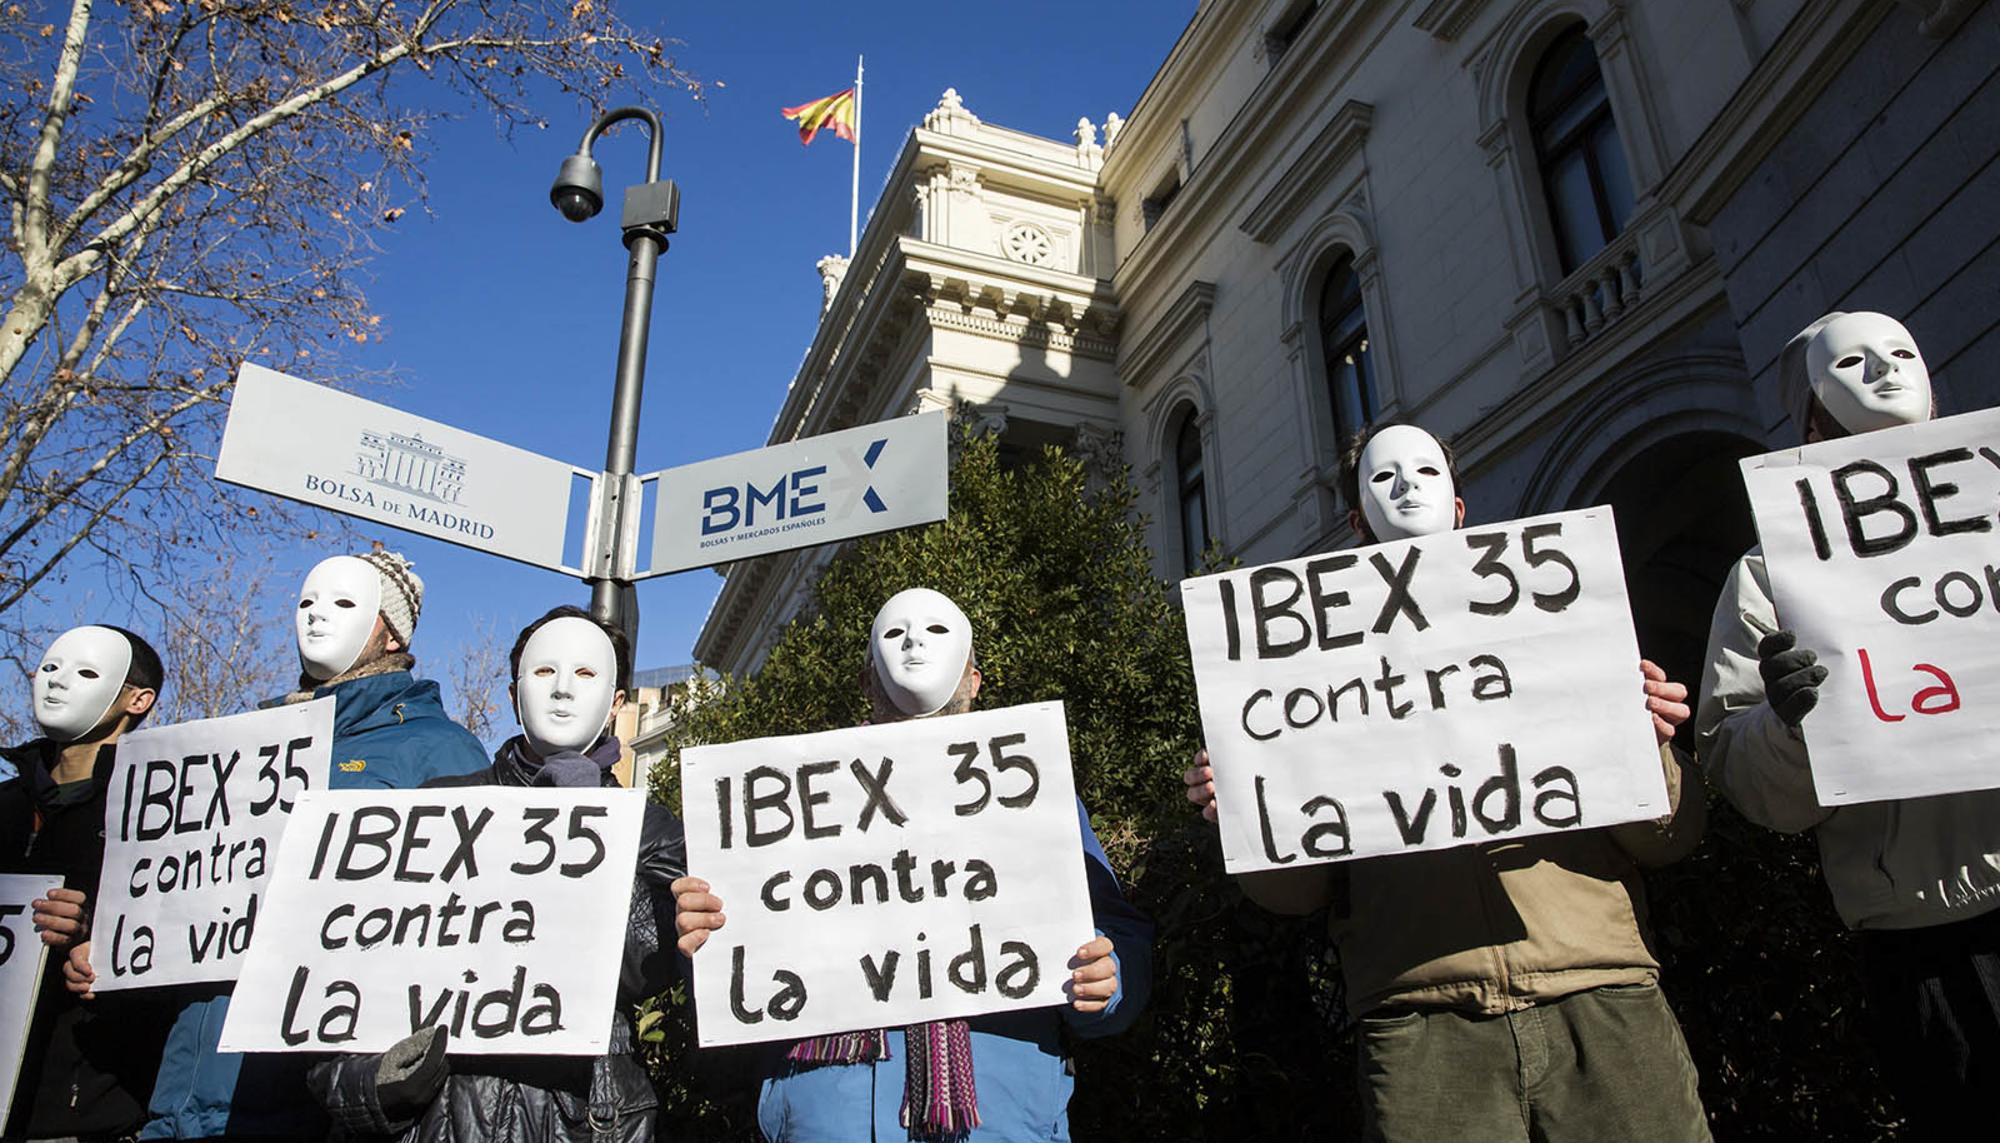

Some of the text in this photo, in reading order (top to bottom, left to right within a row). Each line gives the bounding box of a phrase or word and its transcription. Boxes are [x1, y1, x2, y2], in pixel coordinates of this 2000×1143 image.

[305, 474, 376, 507] BOLSA
[408, 503, 495, 540] MADRID
[701, 535, 728, 549] BOLSAS
[737, 526, 780, 541] MERCADOS
[781, 517, 827, 533] ESPAÑOLES
[1219, 523, 1580, 660] IBEX 35
[1242, 655, 1512, 740] contra
[1858, 649, 1960, 722] la
[121, 737, 312, 842] IBEX 35
[717, 734, 1039, 848] IBEX 35
[1255, 744, 1583, 864] la vida
[130, 832, 266, 898] contra
[310, 806, 608, 883] IBEX 35
[761, 850, 998, 911] contra
[112, 894, 257, 977] la vid
[321, 892, 536, 950] contra
[281, 966, 565, 1046] la vida
[730, 924, 1040, 1024] la vida
